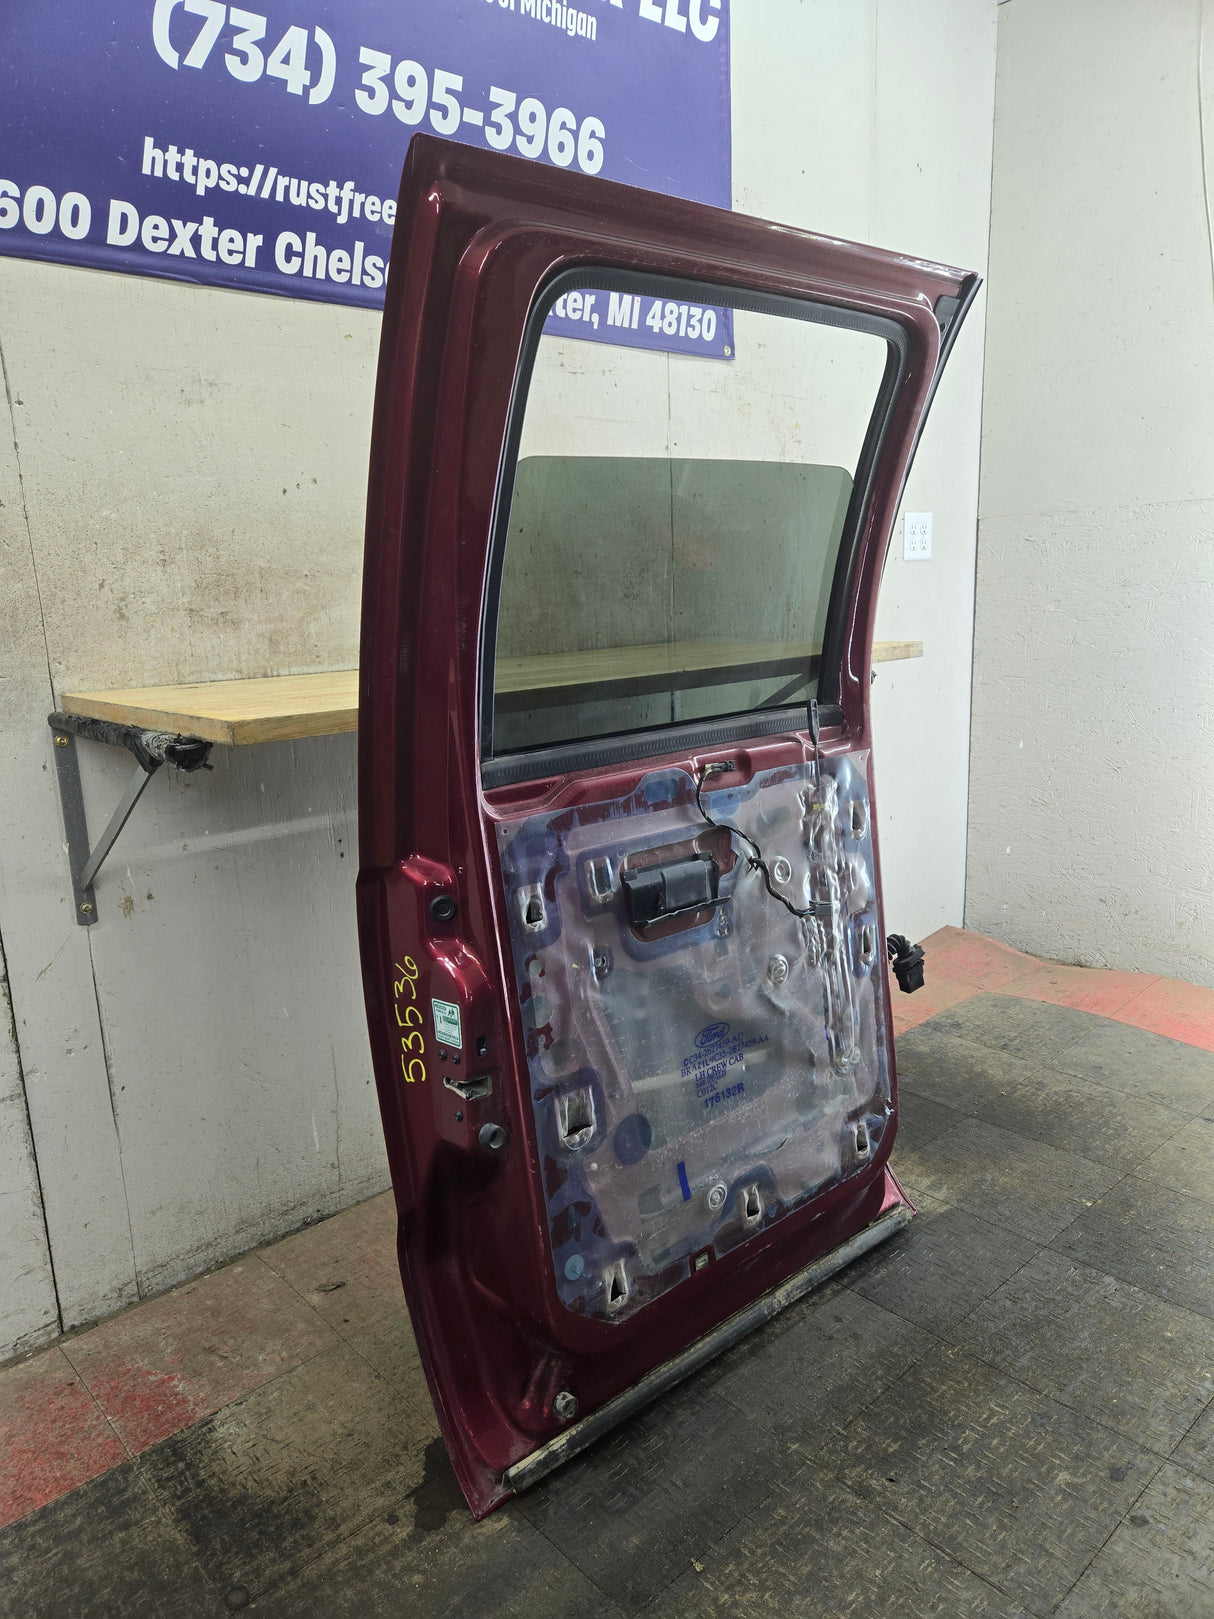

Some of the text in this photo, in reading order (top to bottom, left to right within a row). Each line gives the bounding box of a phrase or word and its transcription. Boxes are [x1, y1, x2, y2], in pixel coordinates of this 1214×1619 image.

[153, 0, 606, 175] (734) 395-3966
[142, 136, 397, 225] https://rustfree
[106, 199, 263, 268] Dexter
[274, 231, 390, 288] Chels
[549, 291, 717, 342] ter, MI 48130
[394, 956, 426, 1083] 53536
[699, 1025, 727, 1046] Ford
[695, 1070, 706, 1082] LH
[706, 1060, 728, 1077] CREW
[728, 1053, 744, 1067] CAB
[704, 1082, 745, 1109] 176132R
